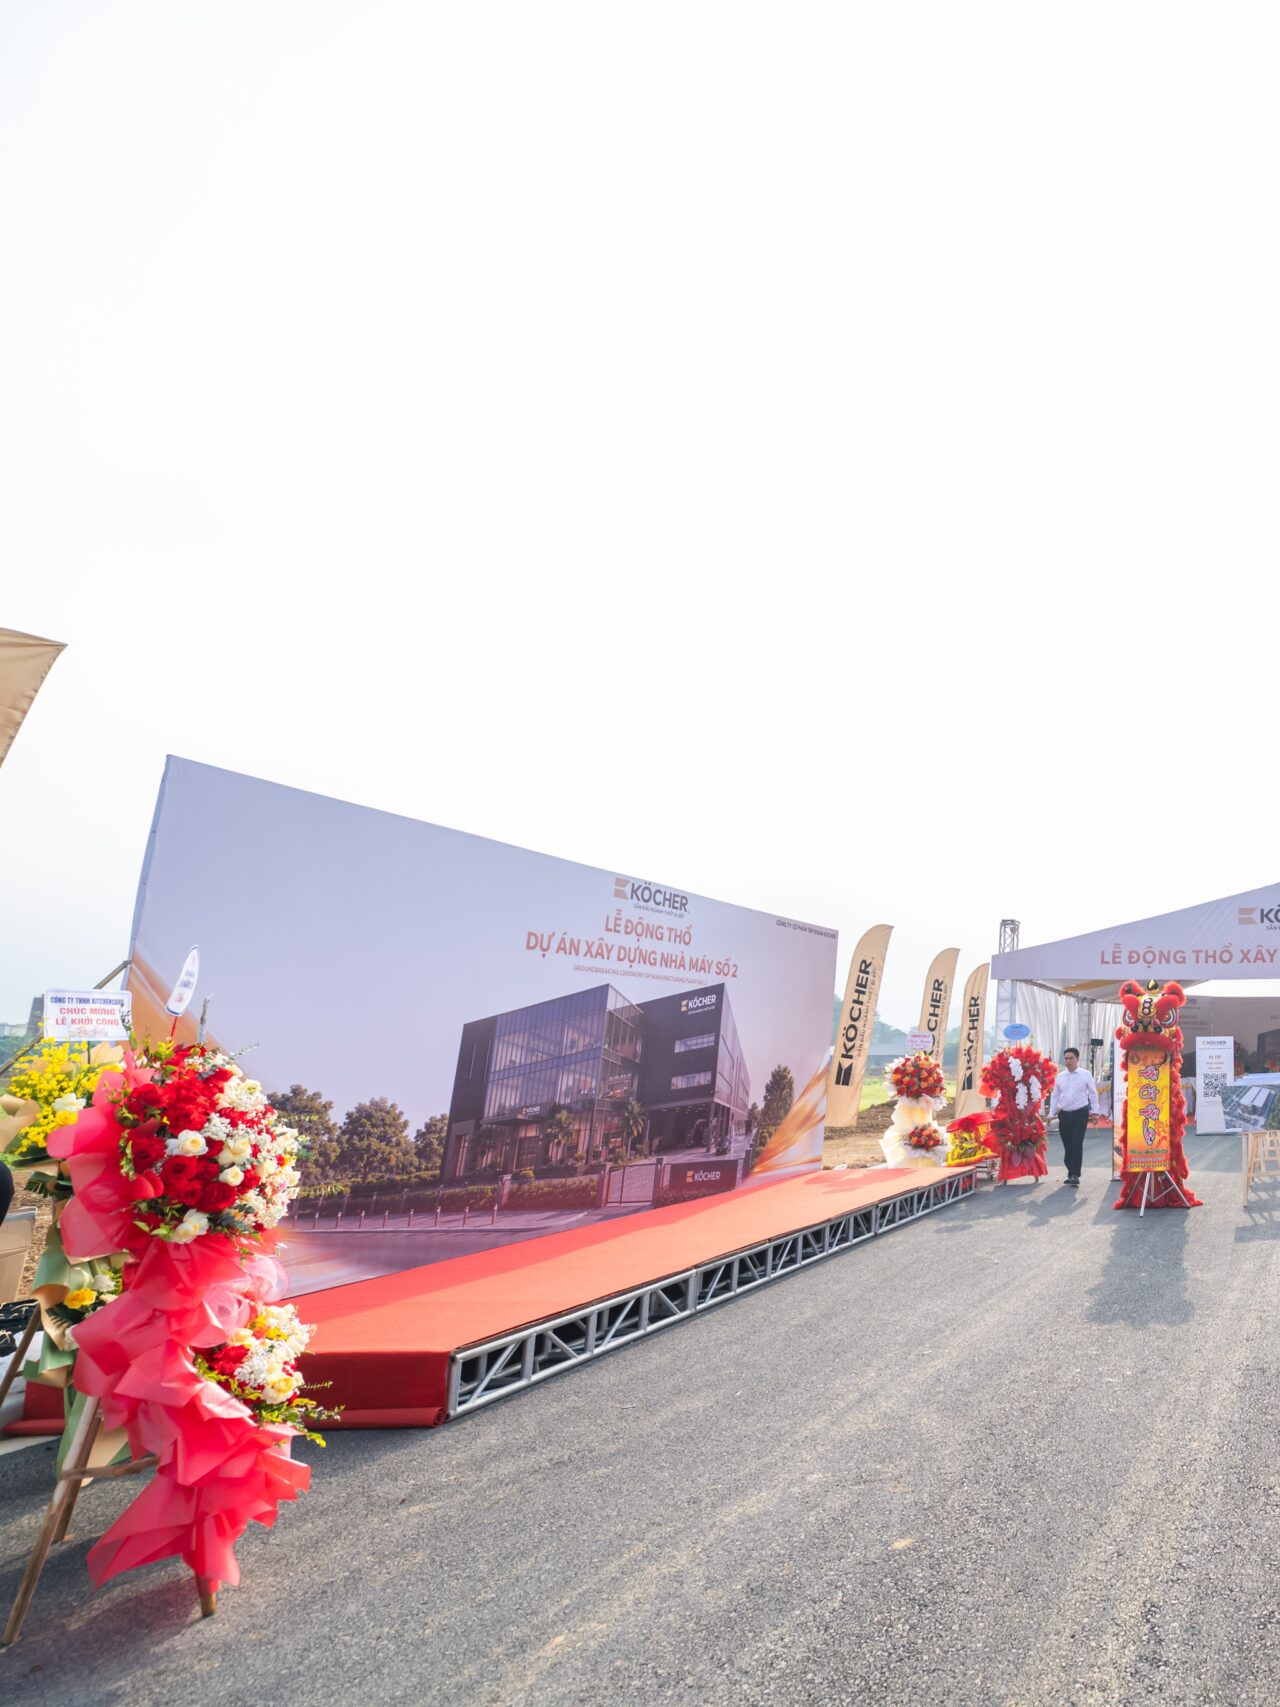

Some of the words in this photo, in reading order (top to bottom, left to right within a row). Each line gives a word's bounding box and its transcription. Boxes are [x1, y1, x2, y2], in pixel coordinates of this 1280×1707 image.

[630, 881, 689, 912] KÖCHER
[605, 908, 622, 934] LỄ
[624, 916, 664, 942] ĐỘNG
[667, 924, 693, 946] THỔ
[526, 931, 555, 959] DỰ
[556, 932, 580, 957] ÁN
[584, 937, 615, 961] XÂY
[617, 944, 657, 969] DỰNG
[660, 951, 685, 971] NHÀ
[689, 955, 714, 976] MÁY
[716, 956, 731, 977] SỐ
[731, 964, 738, 978] 2
[1100, 943, 1122, 965] LỄ
[1127, 946, 1186, 969] ĐỘNG
[1192, 942, 1233, 964] THỔ
[1239, 944, 1278, 964] XÂY
[50, 996, 66, 1004] CÔNG
[59, 1006, 87, 1015] CHÚC
[688, 994, 717, 1009] KÖCHER
[841, 959, 872, 1060] KÖCHER
[55, 1016, 68, 1026] LỄ
[95, 1018, 120, 1026] CÔNG
[924, 978, 944, 1056] CHER
[694, 1170, 721, 1181] KÖCHER
